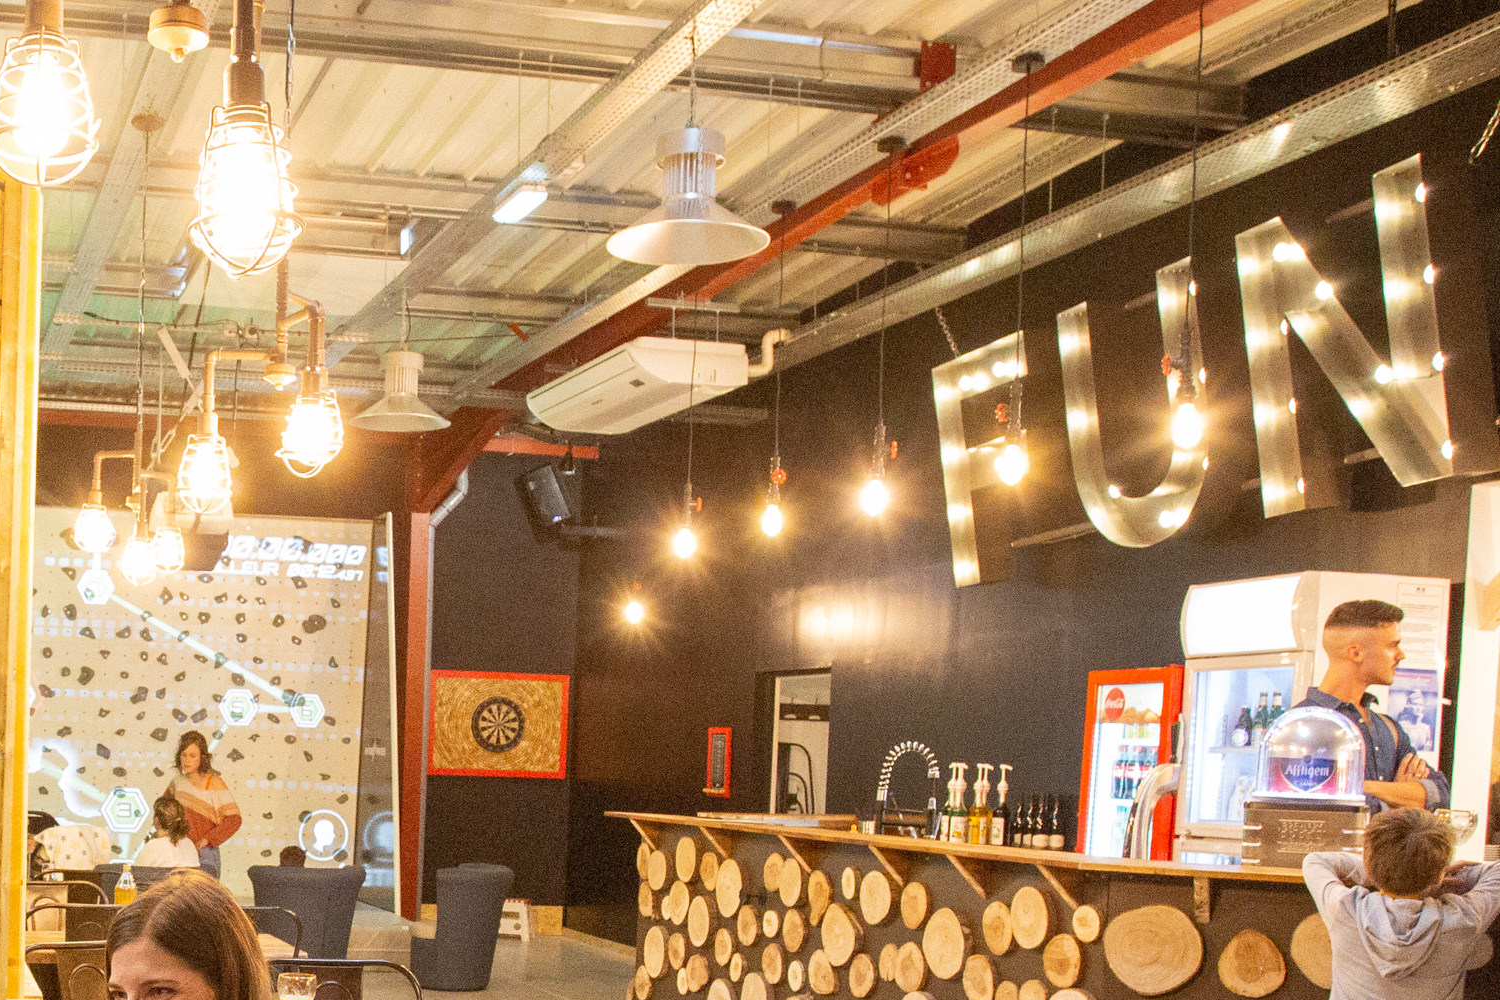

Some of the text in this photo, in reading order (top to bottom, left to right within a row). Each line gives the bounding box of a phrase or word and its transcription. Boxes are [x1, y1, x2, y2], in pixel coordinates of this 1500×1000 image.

[931, 152, 1454, 588] FUN
[1284, 764, 1330, 778] Affligem
[116, 802, 132, 818] 3
